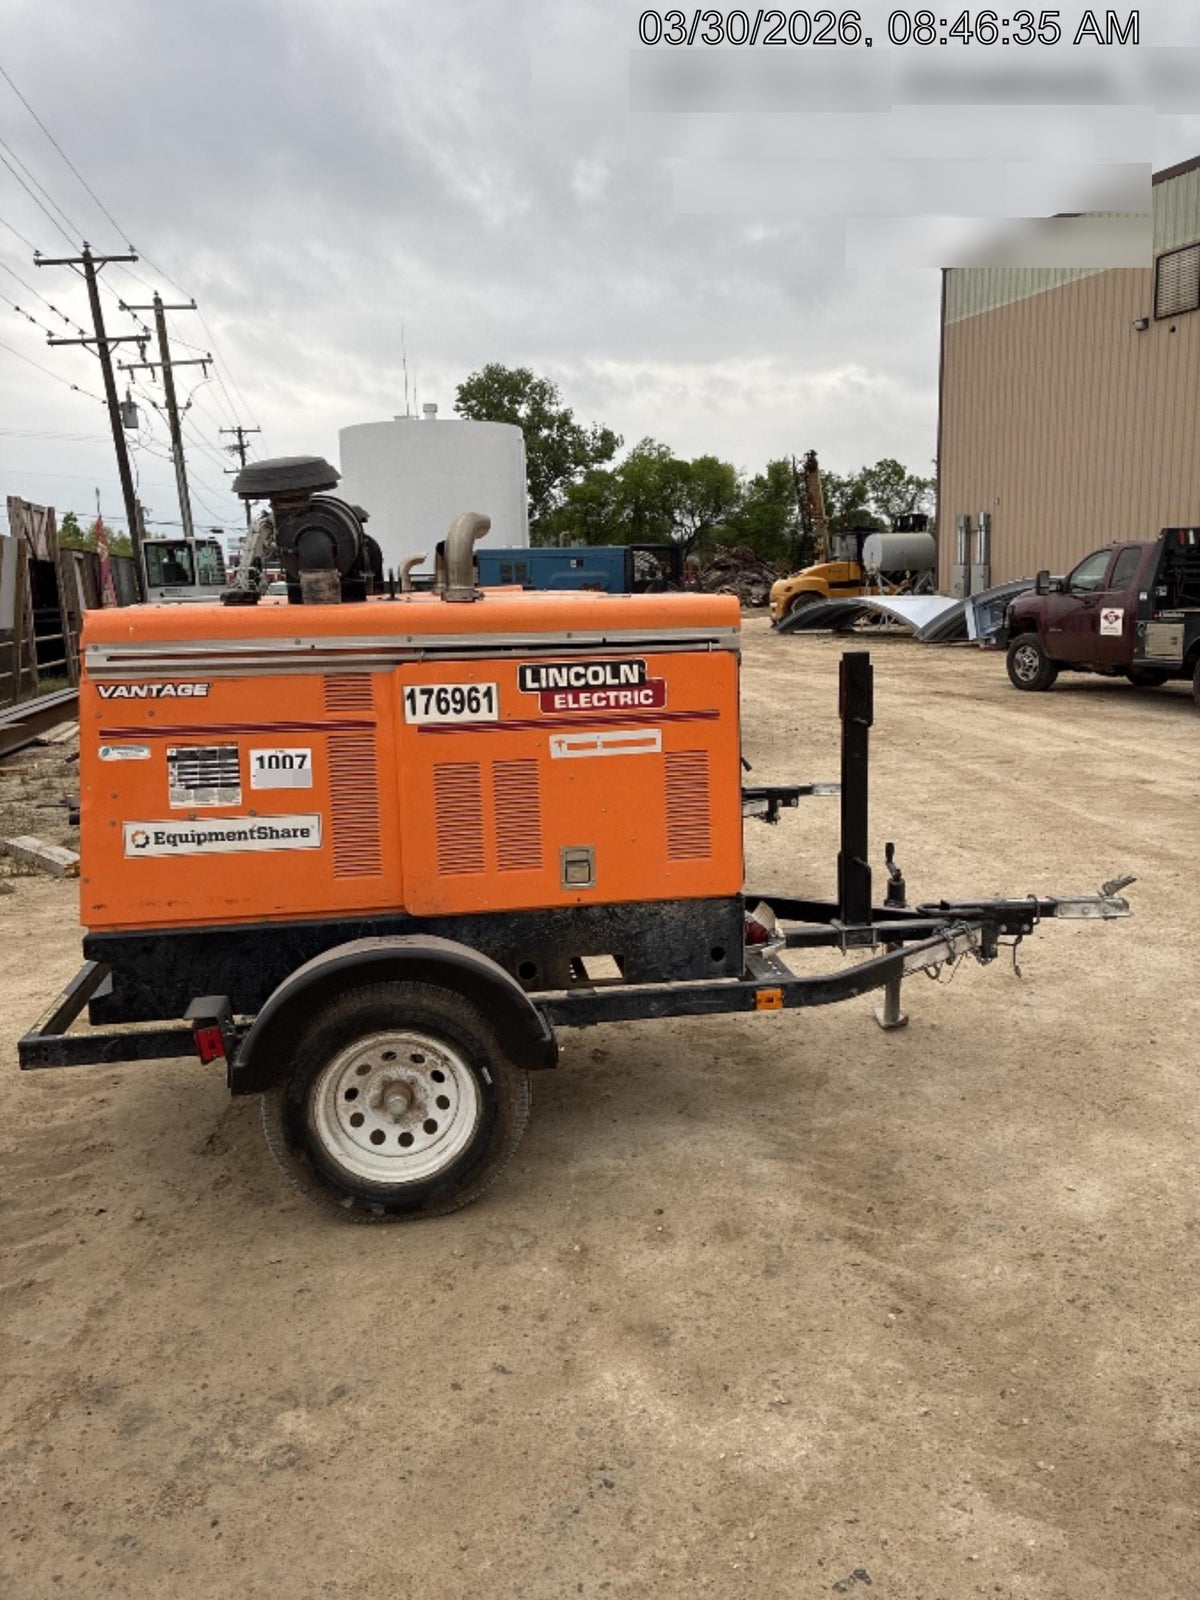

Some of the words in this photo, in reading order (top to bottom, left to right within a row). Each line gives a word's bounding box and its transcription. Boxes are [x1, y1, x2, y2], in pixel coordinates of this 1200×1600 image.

[525, 664, 639, 689] LINCOLN
[97, 682, 209, 699] VANTAGE
[405, 685, 493, 716] 176961
[554, 689, 653, 708] ELECTRIC
[154, 826, 310, 847] EquipmentShare
